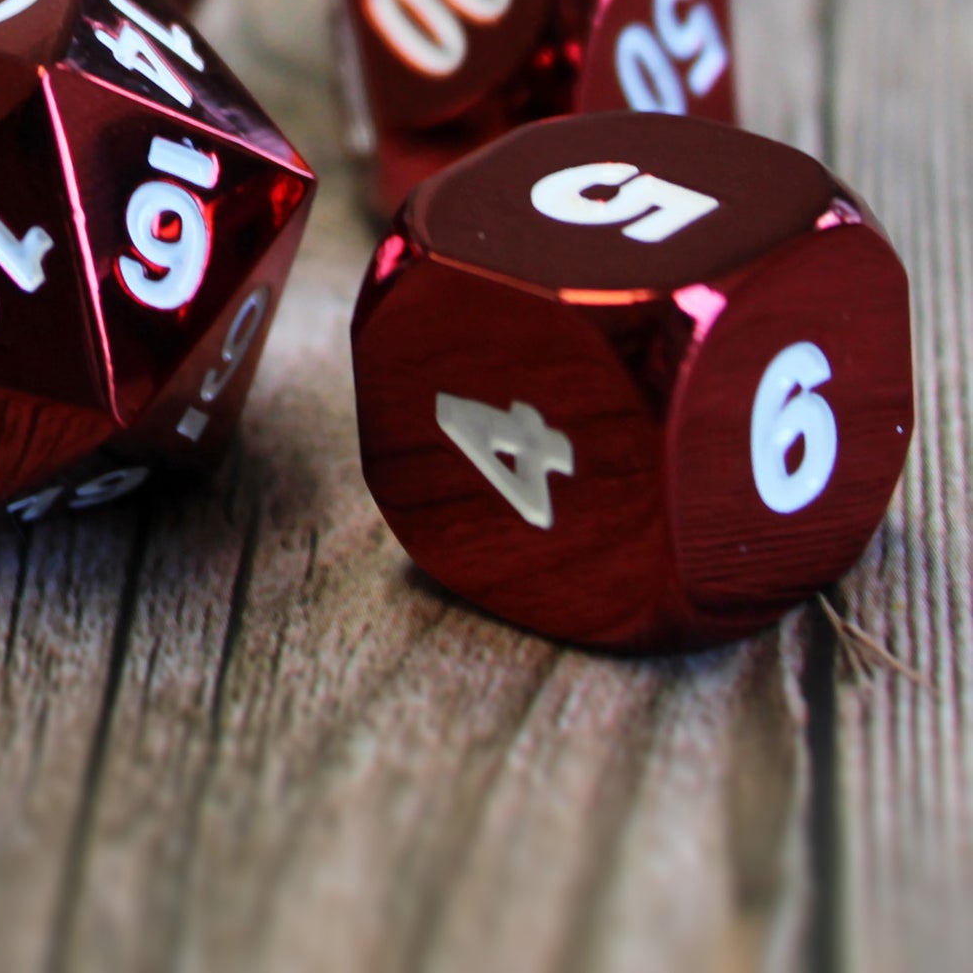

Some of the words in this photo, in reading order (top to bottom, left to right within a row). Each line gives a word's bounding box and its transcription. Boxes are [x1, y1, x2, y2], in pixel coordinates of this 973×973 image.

[530, 161, 719, 243] 5
[435, 391, 575, 530] 4
[750, 340, 838, 515] 6
